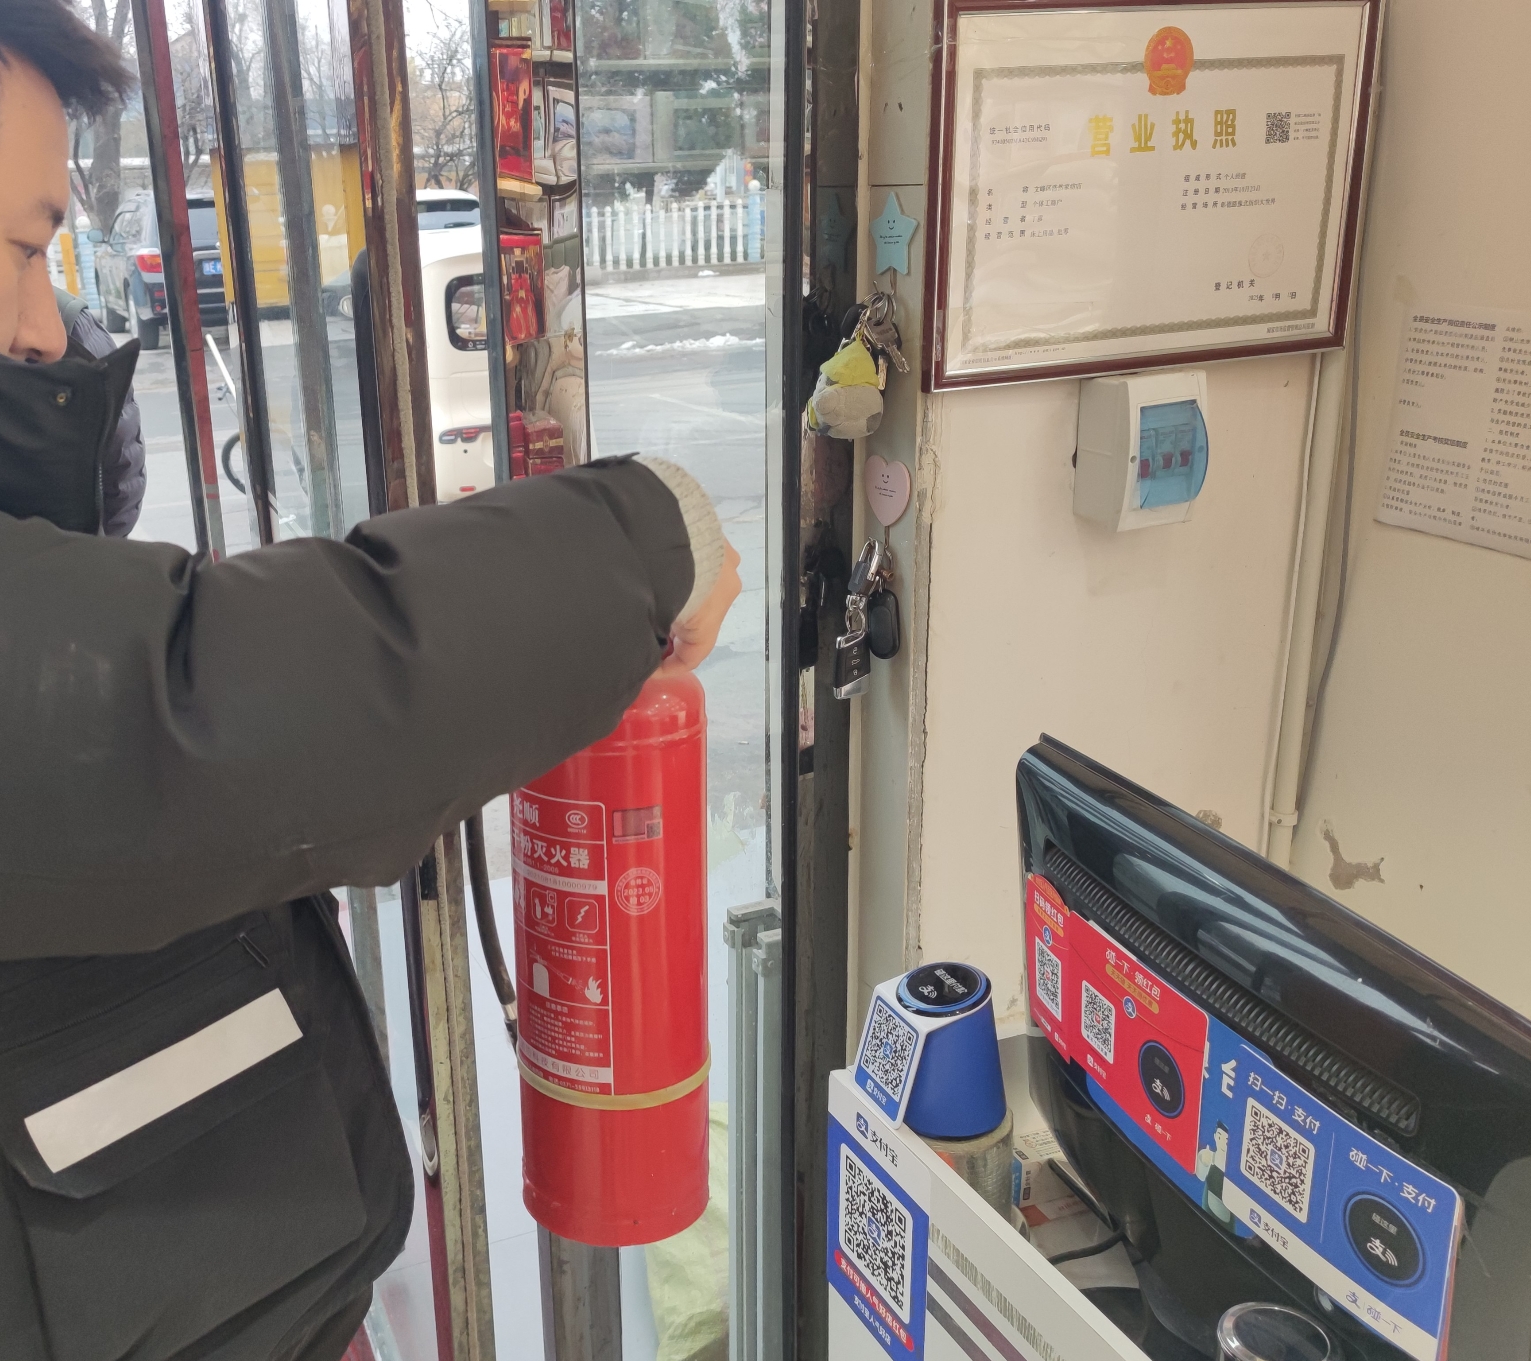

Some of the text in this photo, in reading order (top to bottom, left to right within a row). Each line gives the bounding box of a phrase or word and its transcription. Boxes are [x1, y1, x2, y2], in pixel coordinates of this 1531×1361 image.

[988, 123, 1051, 136] 统一社会信用代码
[1088, 109, 1237, 158] 营业执照
[1213, 278, 1256, 291] 登记机关
[512, 827, 590, 870] 干粉灭火器
[1033, 889, 1064, 928] 扫码领红包
[869, 1128, 899, 1168] 支付宝
[1261, 1220, 1290, 1251] 支付宝
[1365, 1302, 1403, 1335] 碰一下
